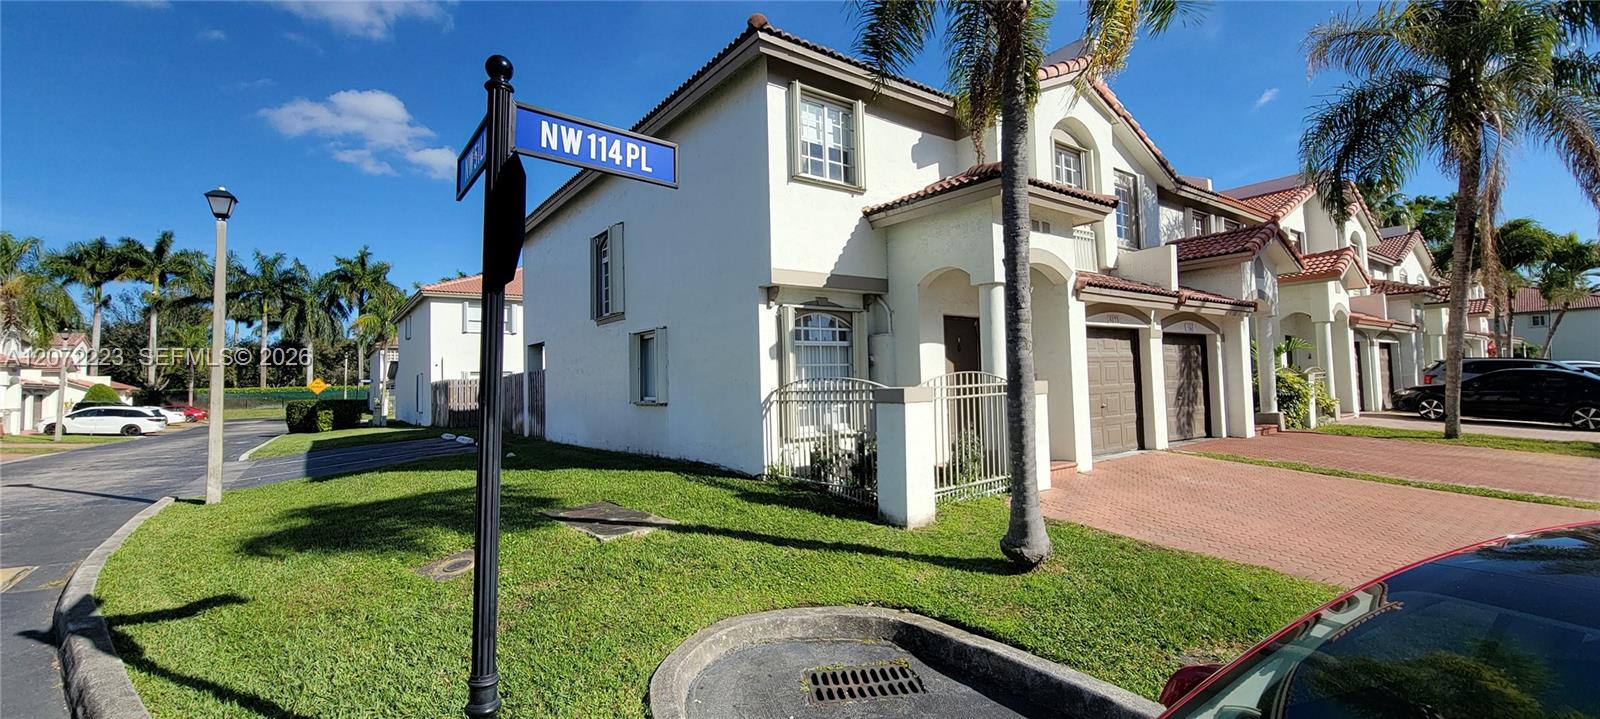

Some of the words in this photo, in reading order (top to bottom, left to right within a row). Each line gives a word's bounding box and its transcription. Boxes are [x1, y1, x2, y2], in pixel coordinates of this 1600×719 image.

[541, 120, 583, 156] NW
[587, 133, 623, 166] 114
[626, 142, 653, 173] PL
